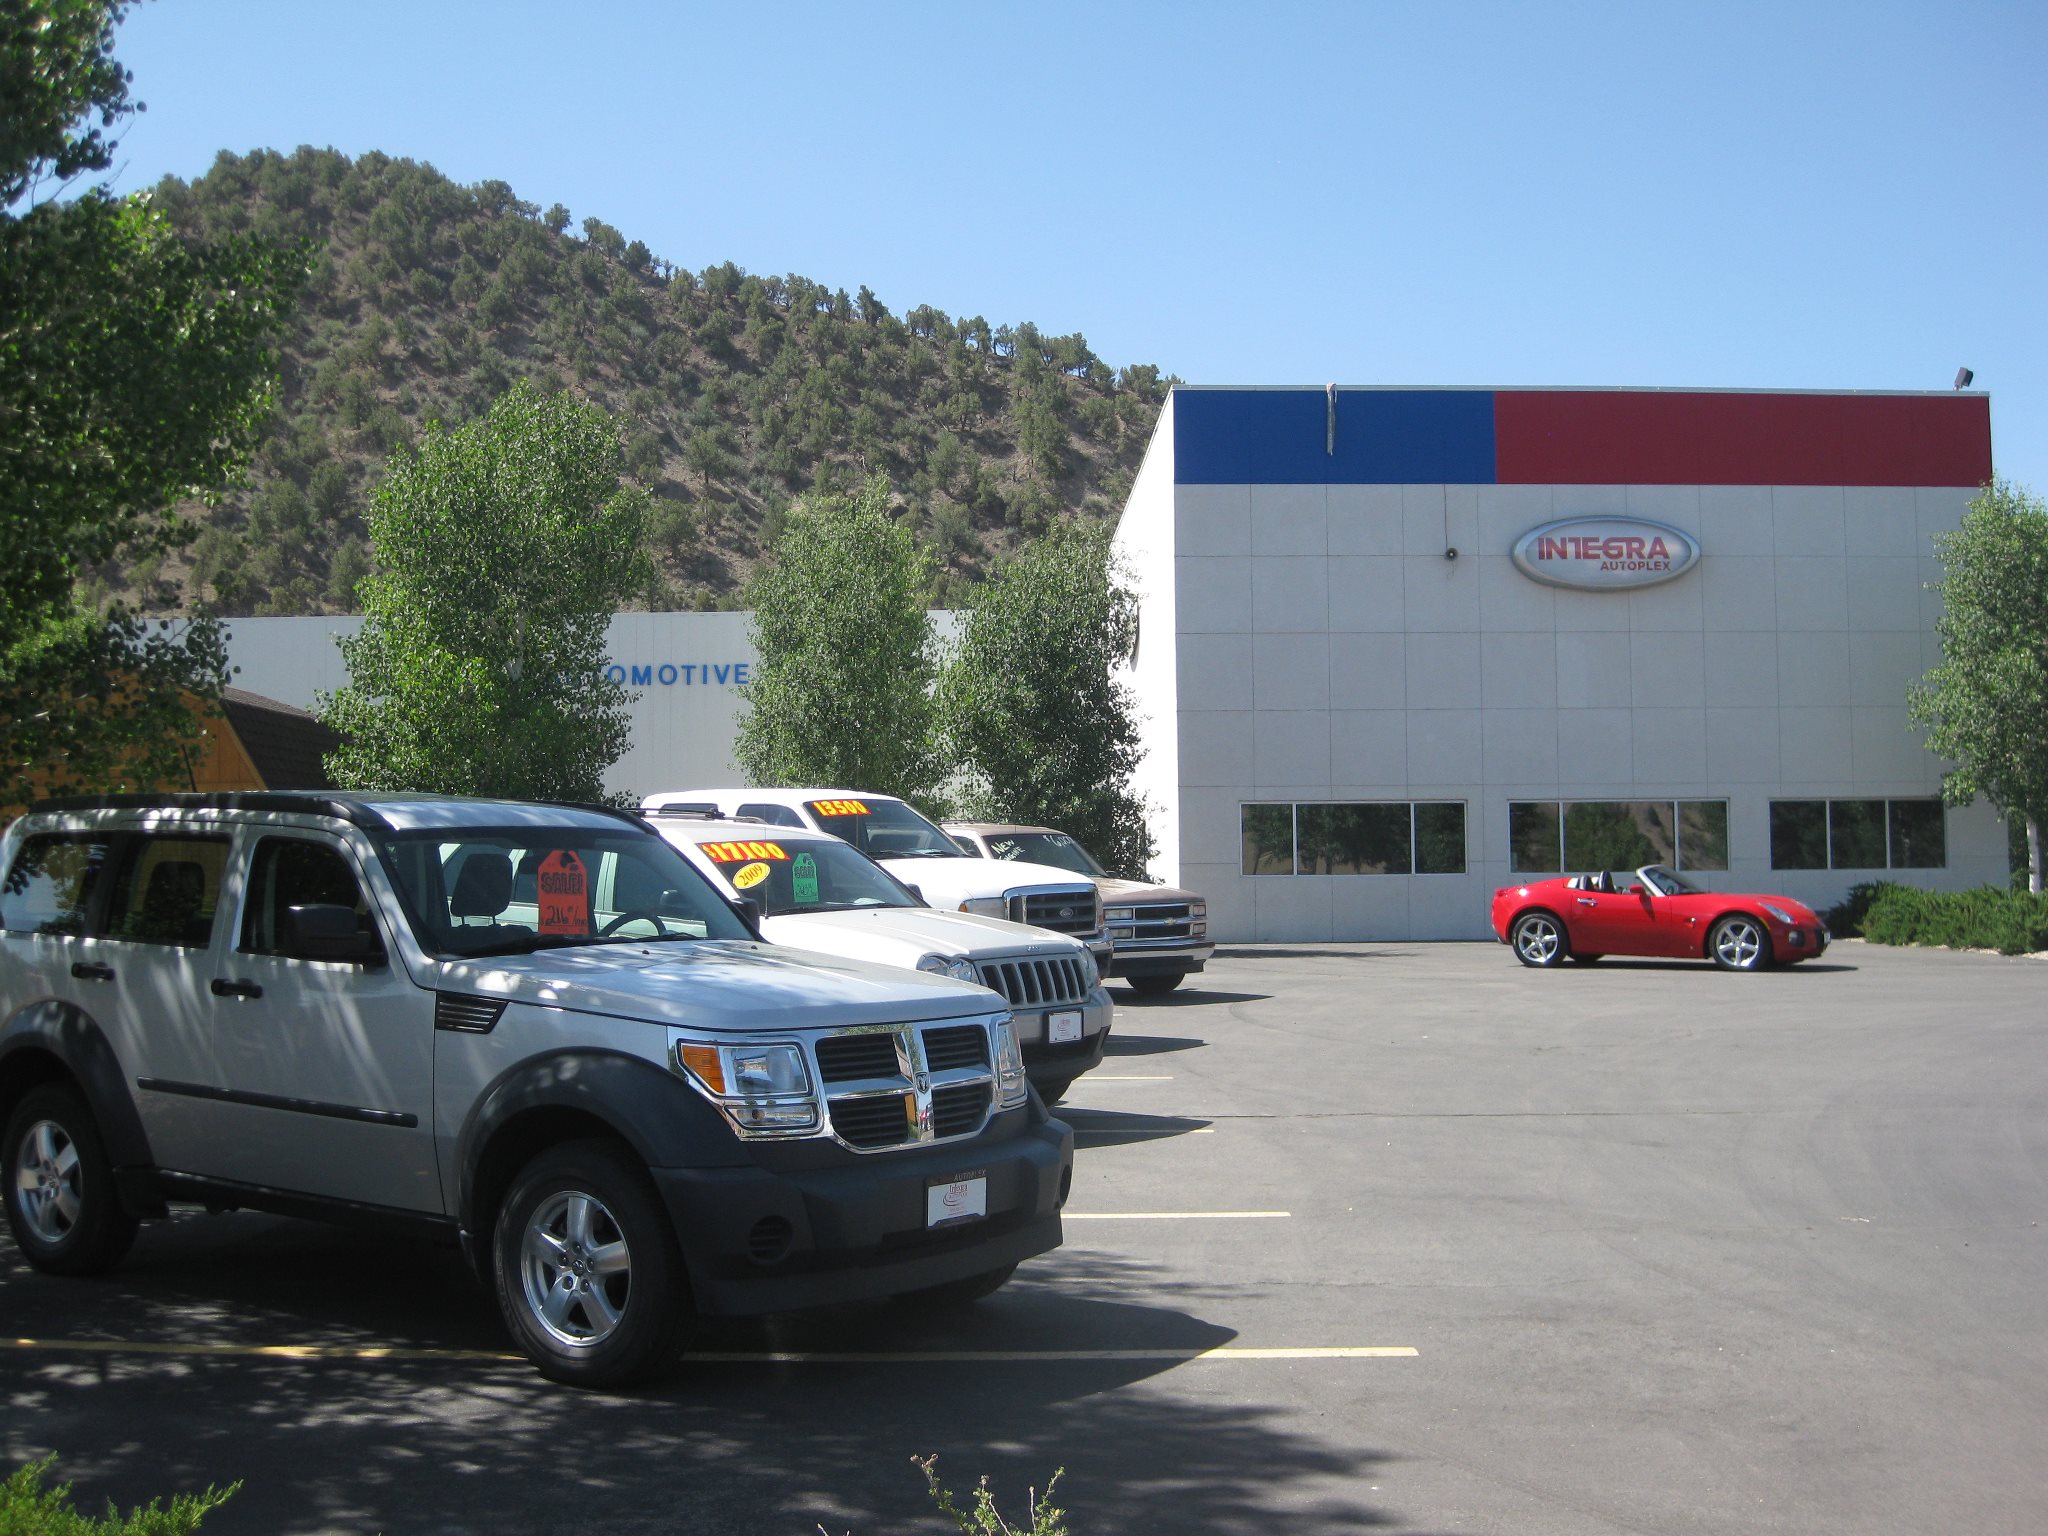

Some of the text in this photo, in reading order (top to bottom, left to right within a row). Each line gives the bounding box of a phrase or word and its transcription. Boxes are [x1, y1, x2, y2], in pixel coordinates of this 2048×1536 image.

[1537, 536, 1671, 560] INTEGRA
[1600, 560, 1671, 571] AUTOPLEX
[813, 801, 870, 816] 13500
[702, 842, 785, 861] $17100
[991, 839, 1015, 854] NEW
[738, 864, 763, 886] 2009
